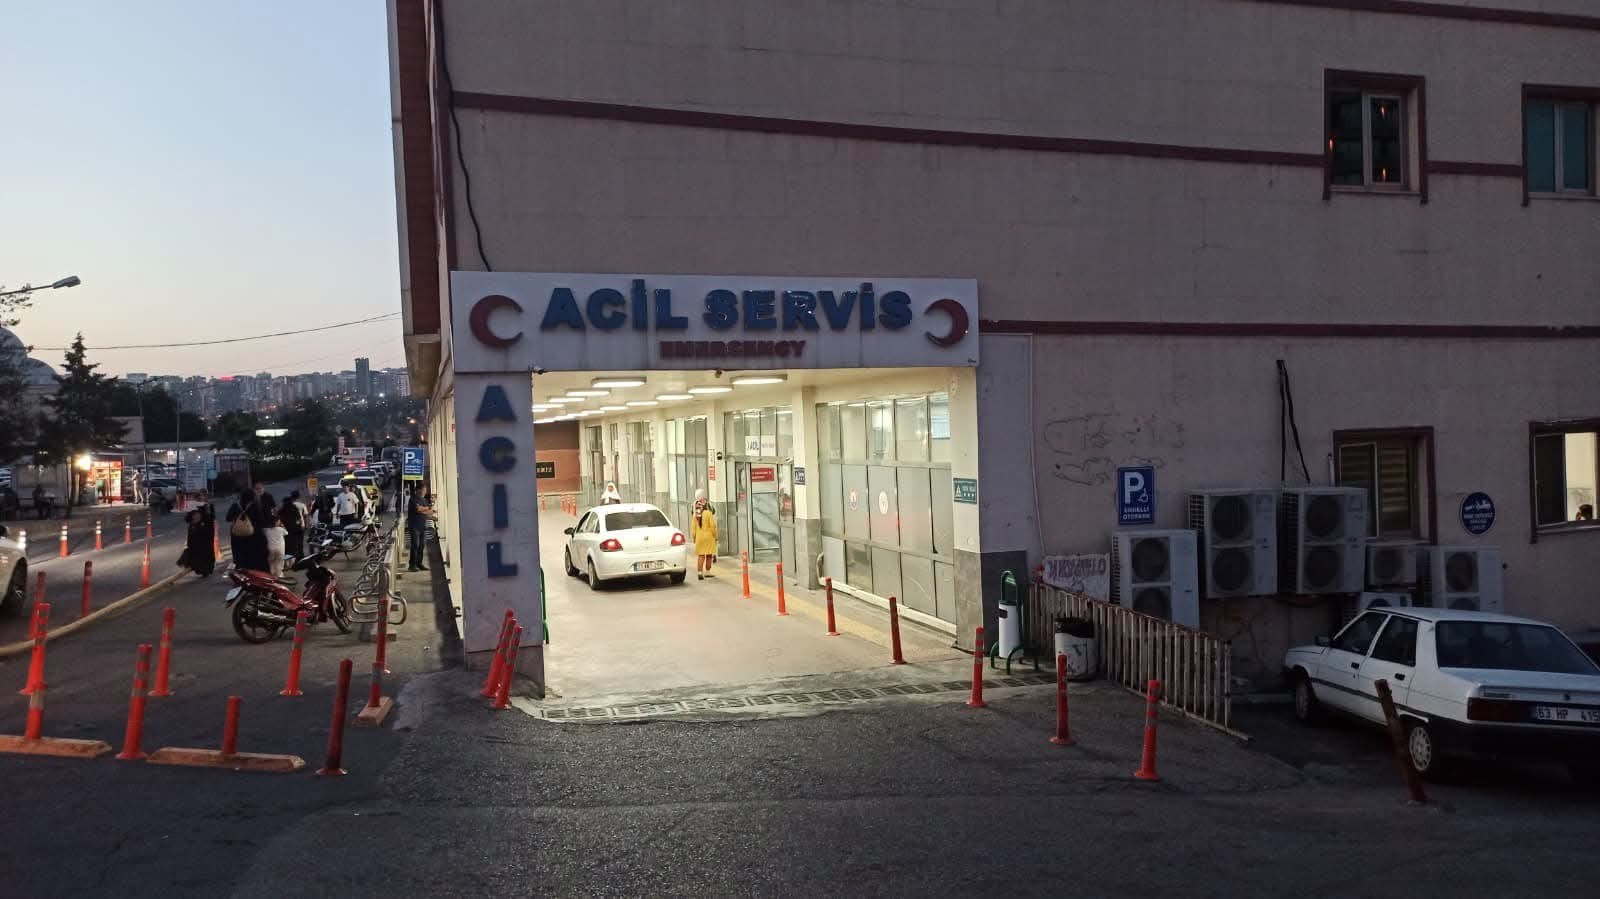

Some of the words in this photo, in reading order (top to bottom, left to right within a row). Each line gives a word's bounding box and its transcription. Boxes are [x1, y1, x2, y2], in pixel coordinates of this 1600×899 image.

[702, 282, 913, 331] SERVİS
[659, 340, 807, 359] EMERGENCY
[405, 451, 416, 464] P
[1124, 471, 1145, 504] P
